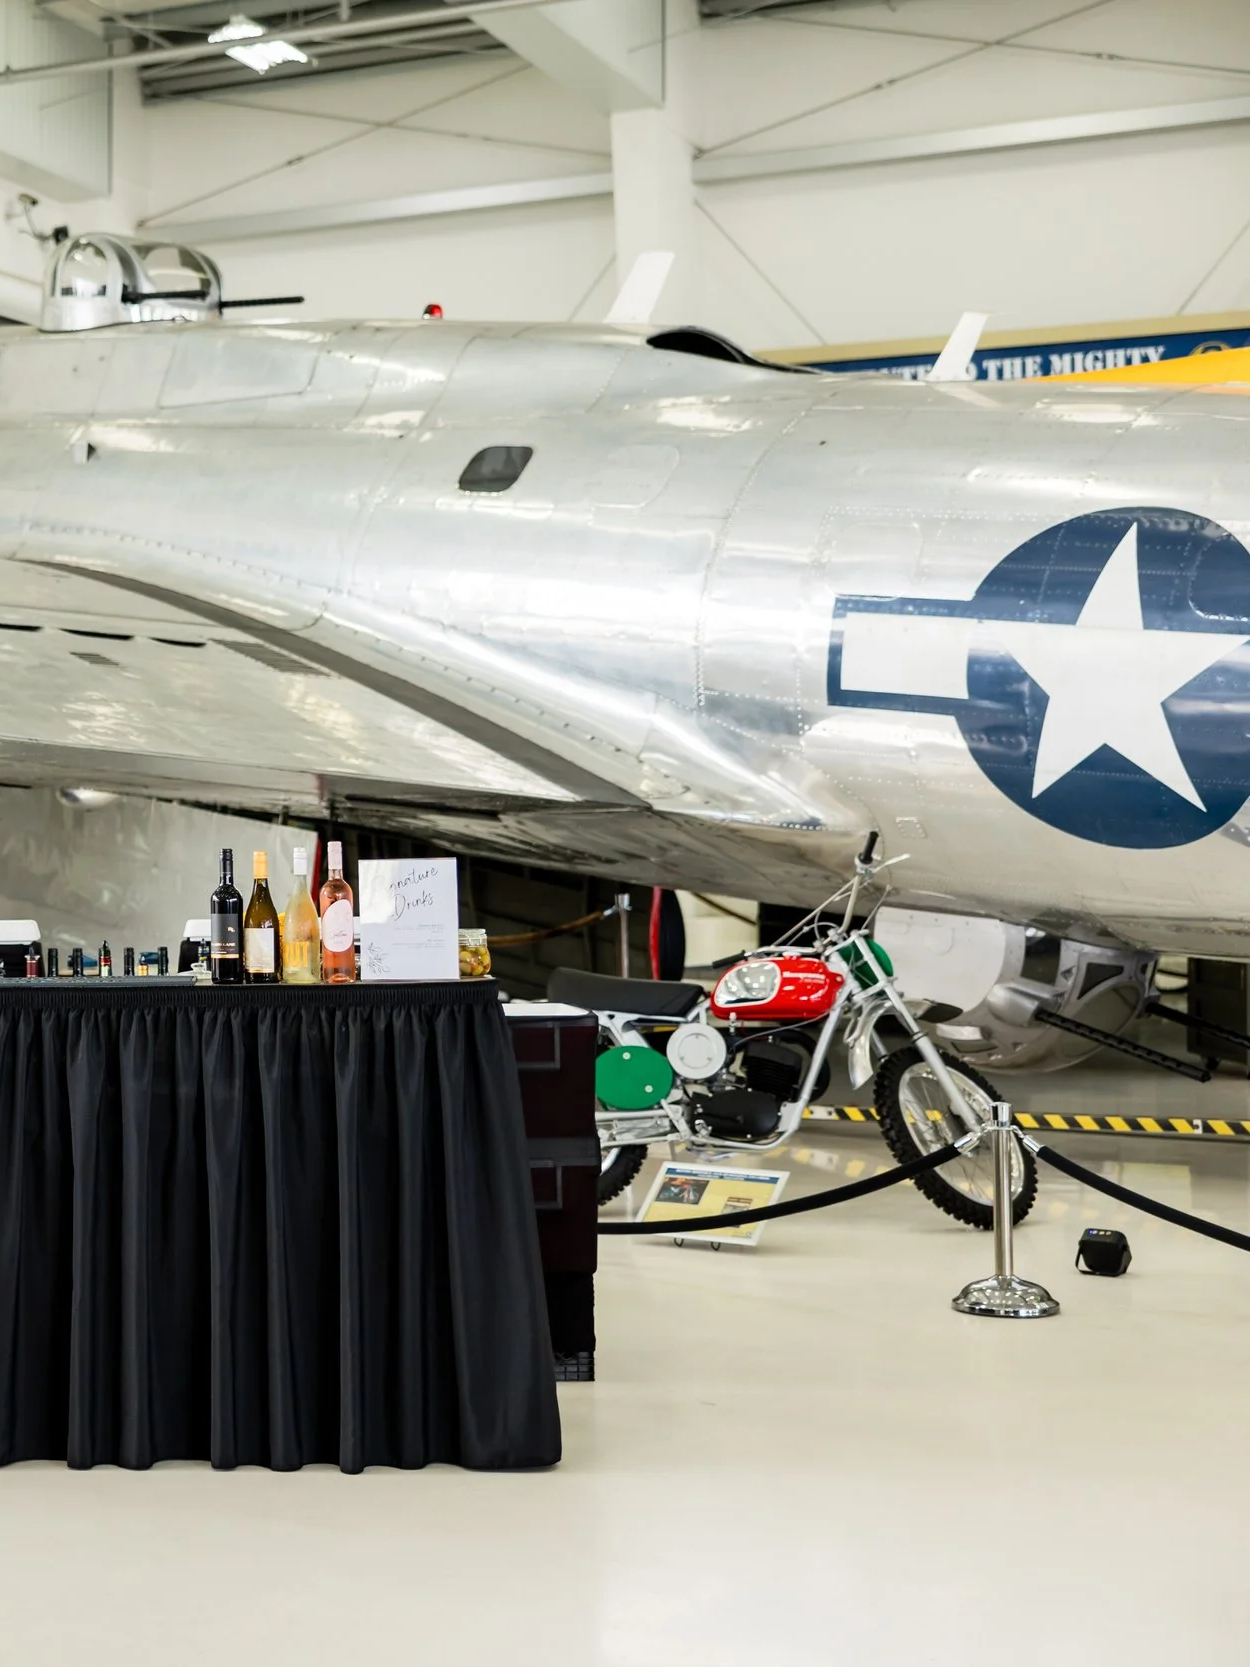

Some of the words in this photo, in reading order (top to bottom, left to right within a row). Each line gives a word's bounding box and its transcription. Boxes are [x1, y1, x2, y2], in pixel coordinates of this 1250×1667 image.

[983, 355, 1044, 380] THE
[1049, 345, 1167, 376] MIGHTY
[391, 890, 434, 921] Drinks
[283, 941, 310, 968] RUT
